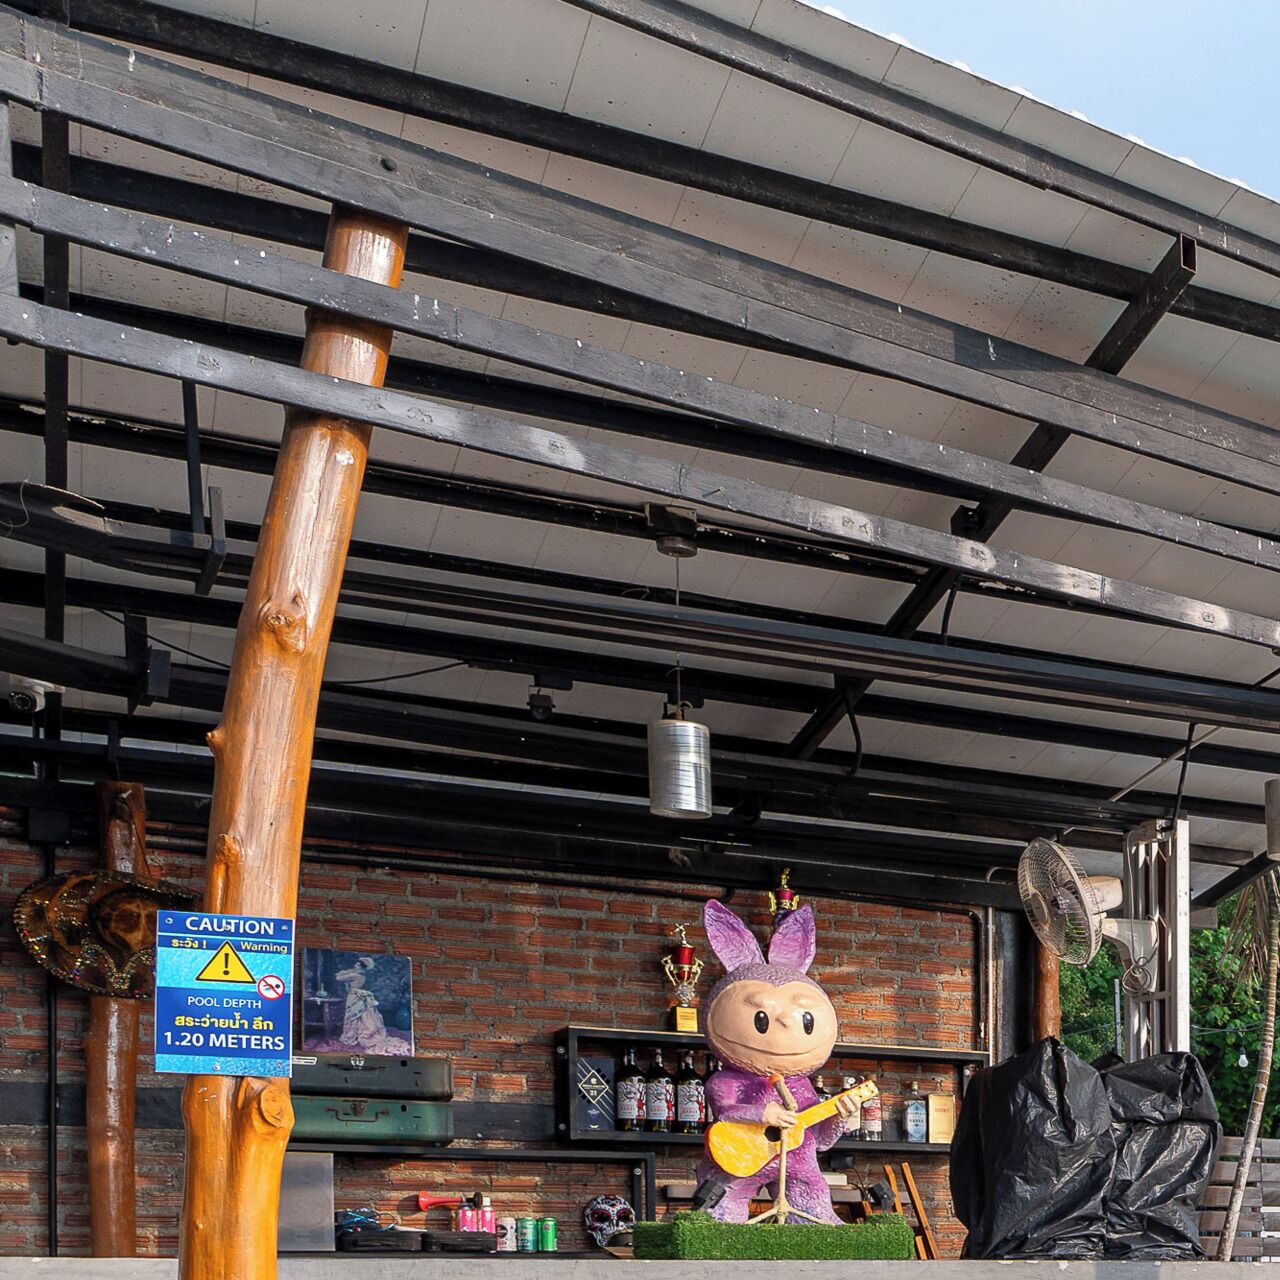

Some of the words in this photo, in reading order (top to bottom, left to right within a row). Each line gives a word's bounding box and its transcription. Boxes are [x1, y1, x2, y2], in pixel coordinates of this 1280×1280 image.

[185, 916, 274, 935] CAUTION
[240, 941, 288, 954] Warning
[187, 996, 220, 1008] POOL
[223, 998, 262, 1010] DEPTH
[174, 1012, 248, 1030] สระว่ายน้ำ
[253, 1015, 274, 1031] ลึก
[164, 1031, 204, 1047] 1.20
[209, 1033, 285, 1050] METERS
